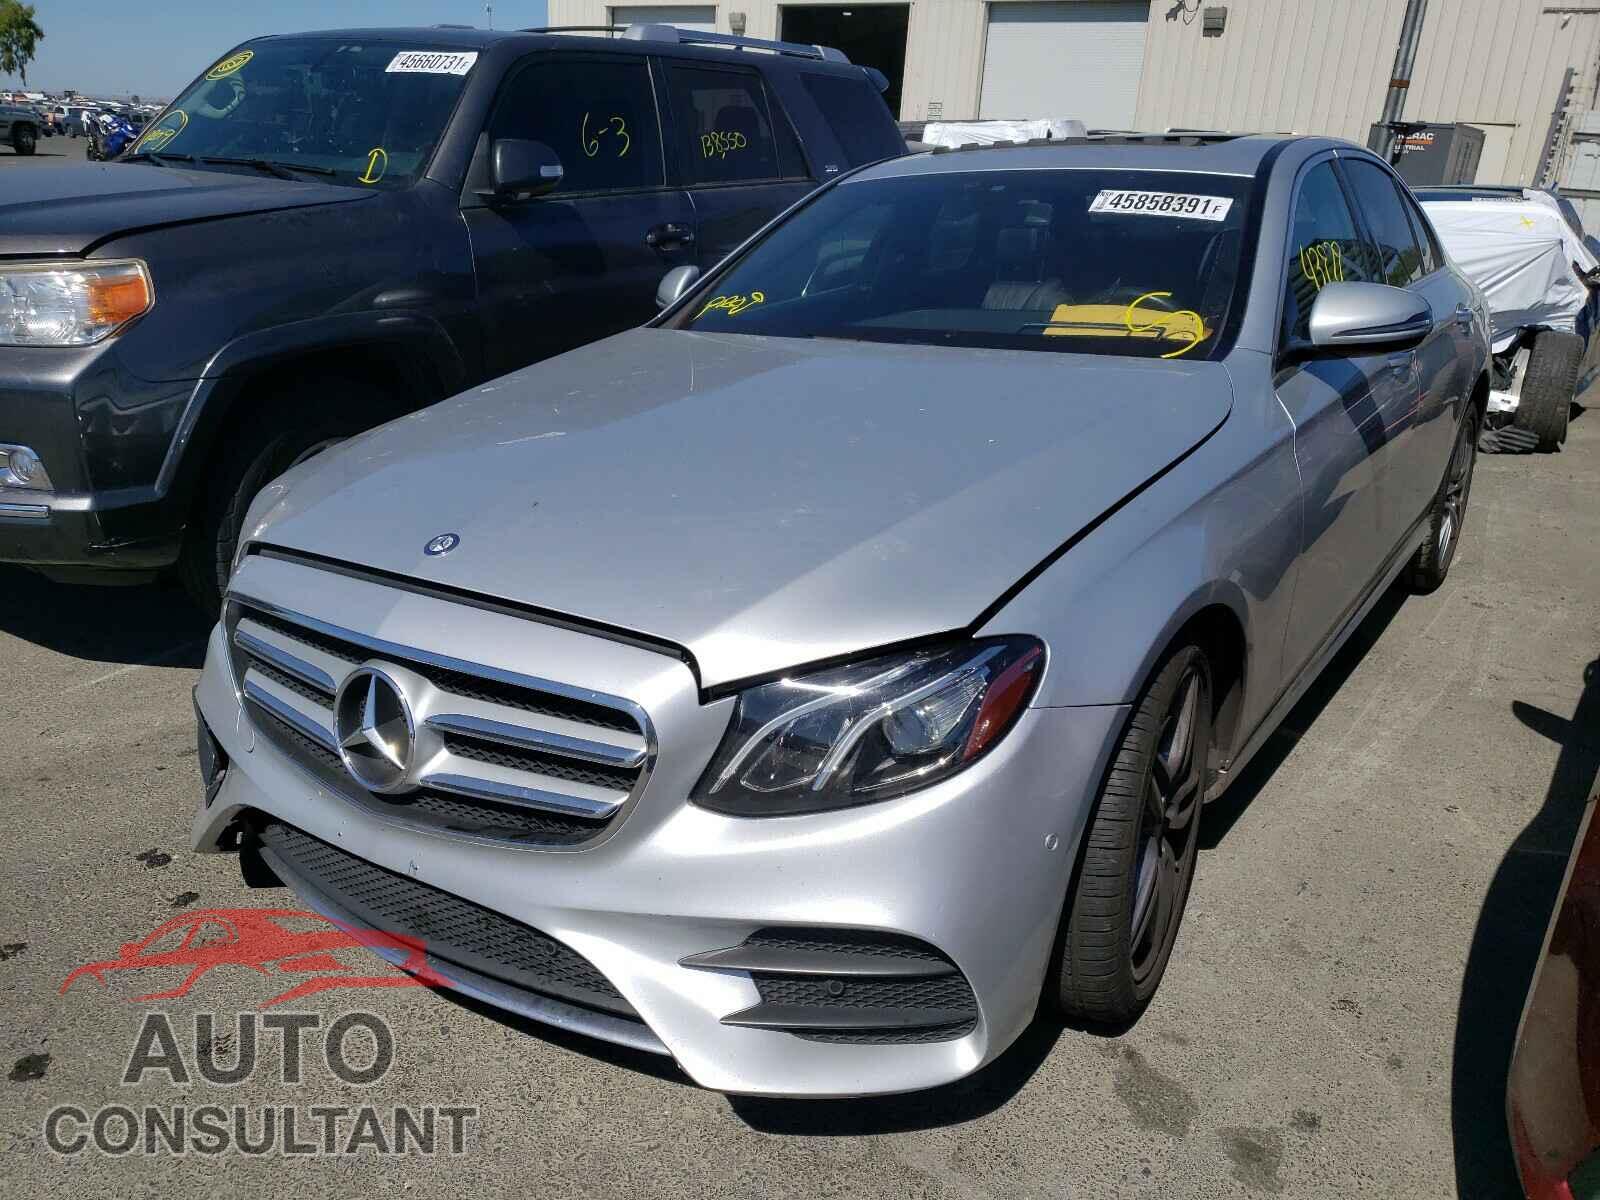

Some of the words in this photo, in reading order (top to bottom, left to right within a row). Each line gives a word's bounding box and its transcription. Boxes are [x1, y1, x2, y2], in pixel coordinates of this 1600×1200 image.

[400, 54, 465, 70] 45660731
[582, 112, 630, 157] 6-3
[1109, 193, 1212, 215] 45858391
[1212, 204, 1223, 214] F
